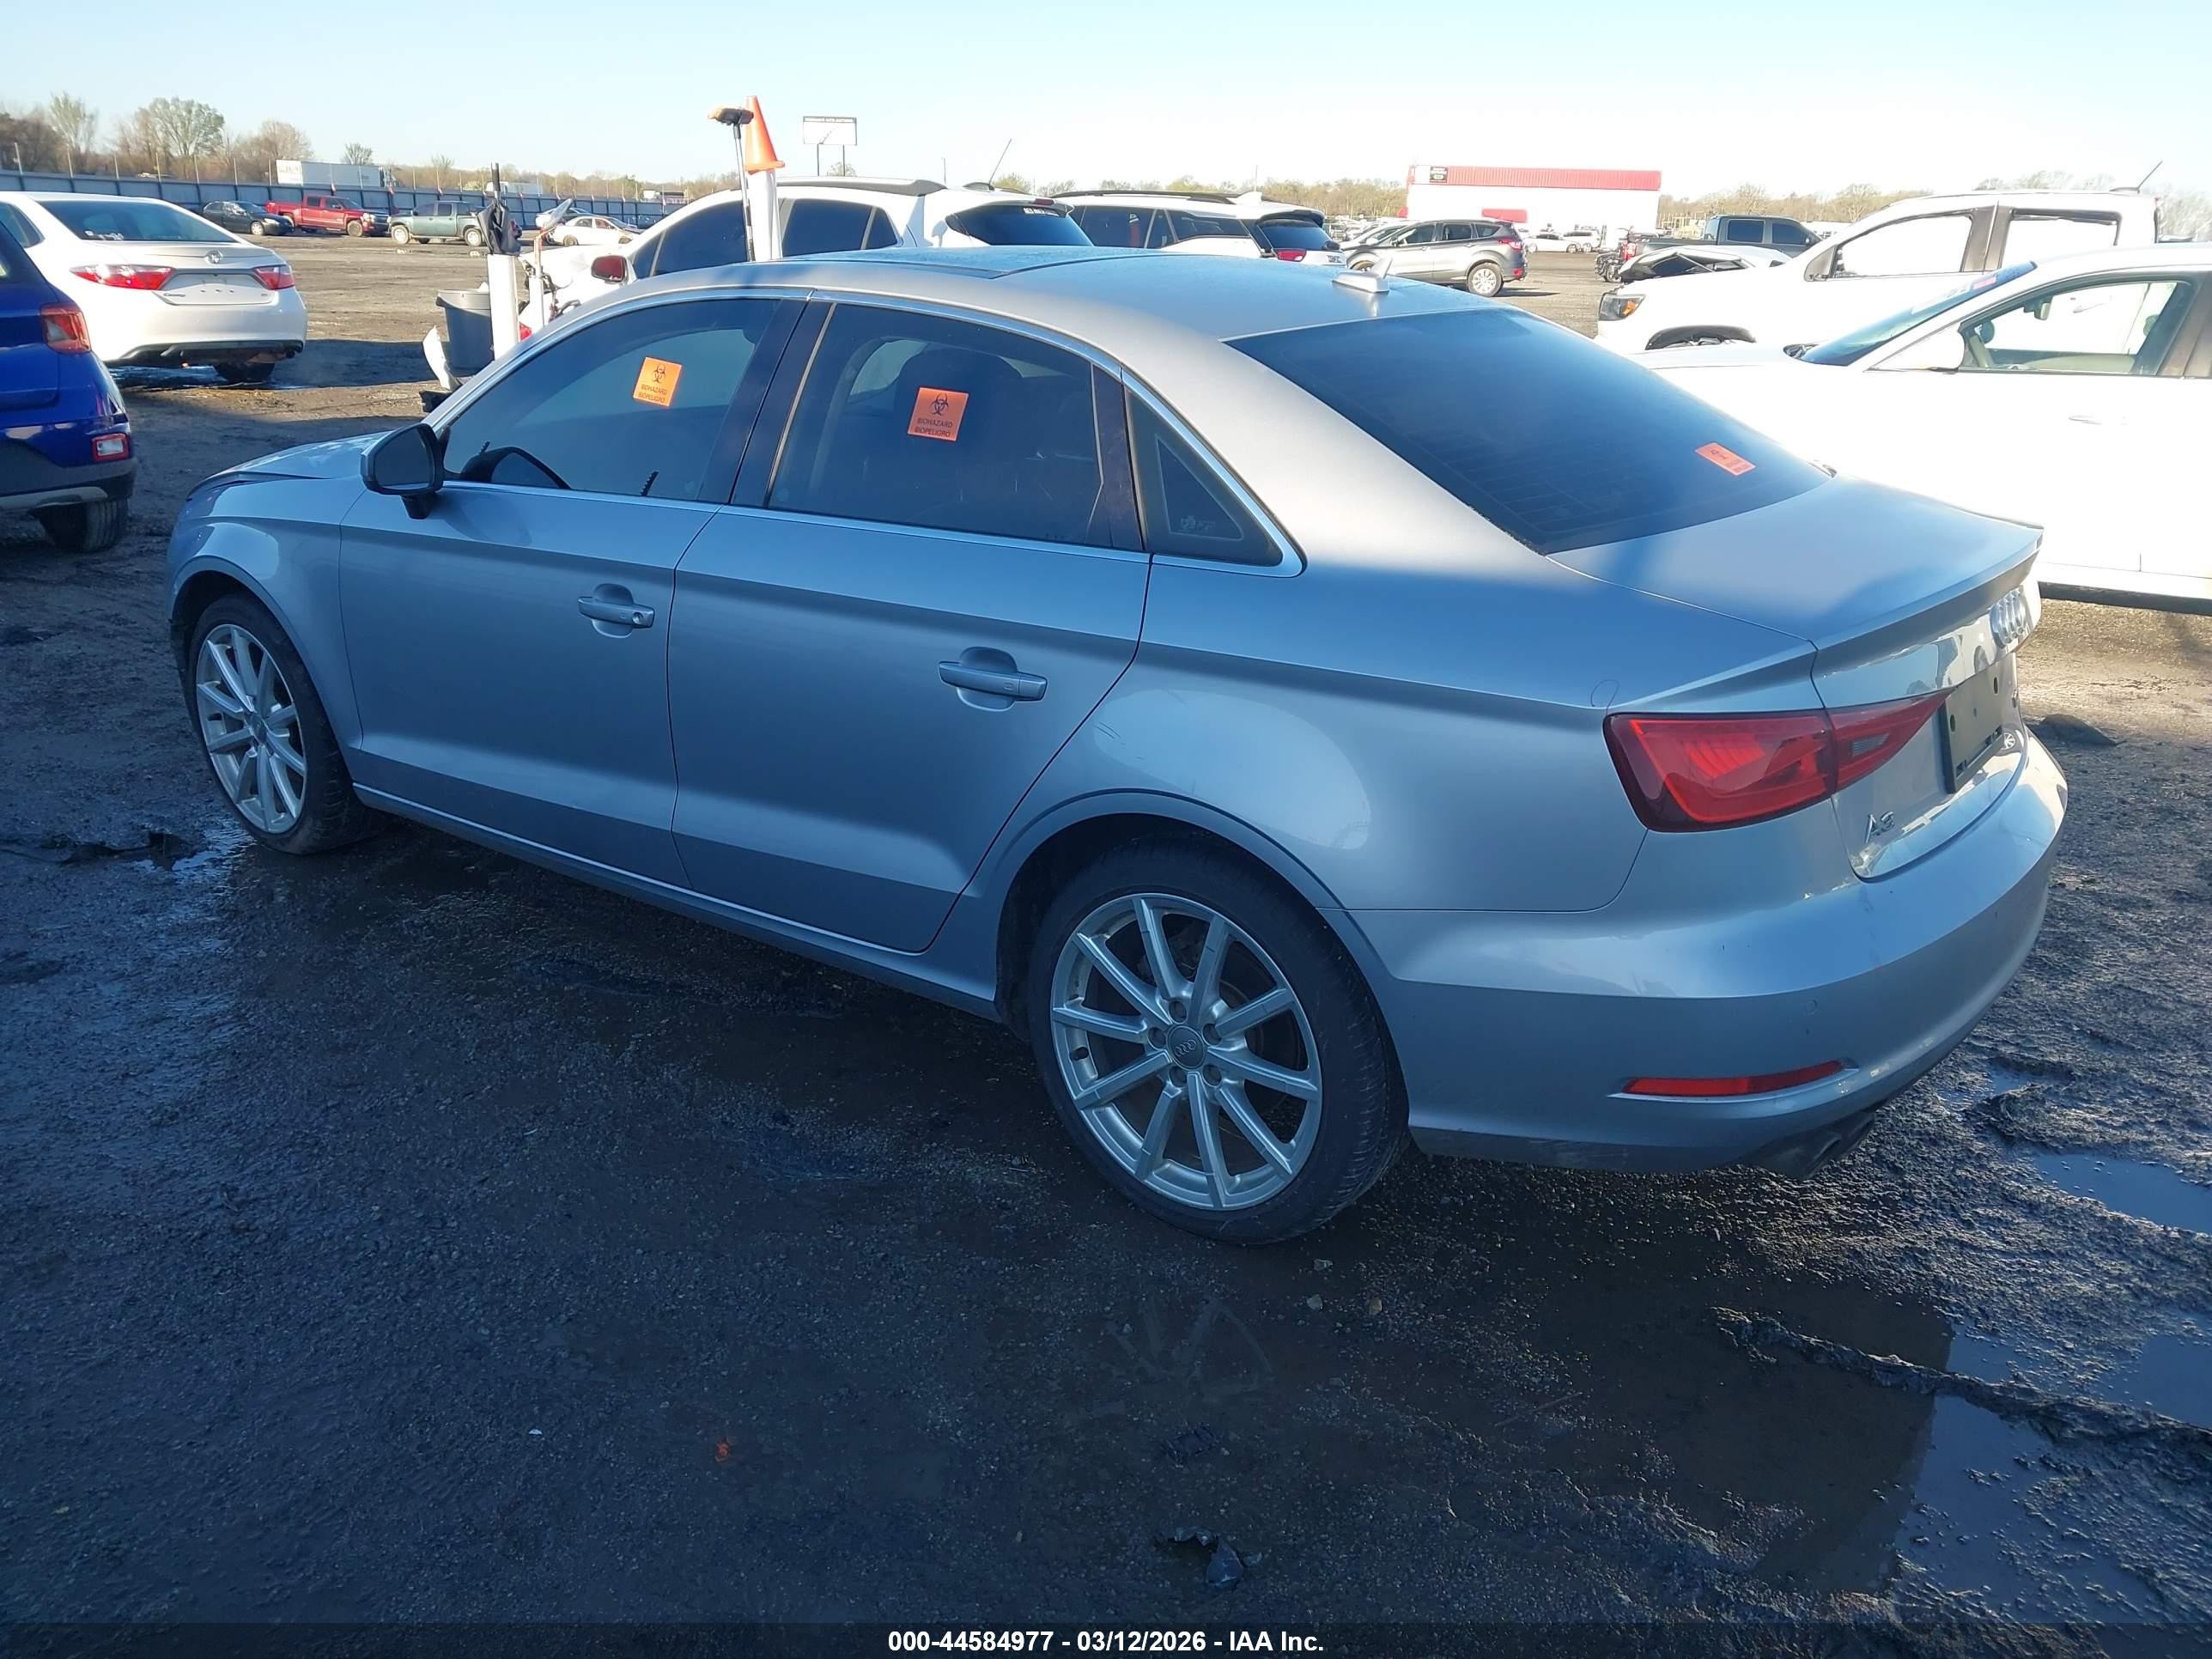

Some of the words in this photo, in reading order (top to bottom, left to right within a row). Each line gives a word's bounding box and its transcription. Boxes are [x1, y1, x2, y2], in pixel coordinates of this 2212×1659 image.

[641, 384, 667, 395] BIOHAZARD
[917, 417, 953, 428] BIOHAZARD
[915, 426, 951, 438] BIOPELIGRO
[1863, 810, 1895, 845] A3
